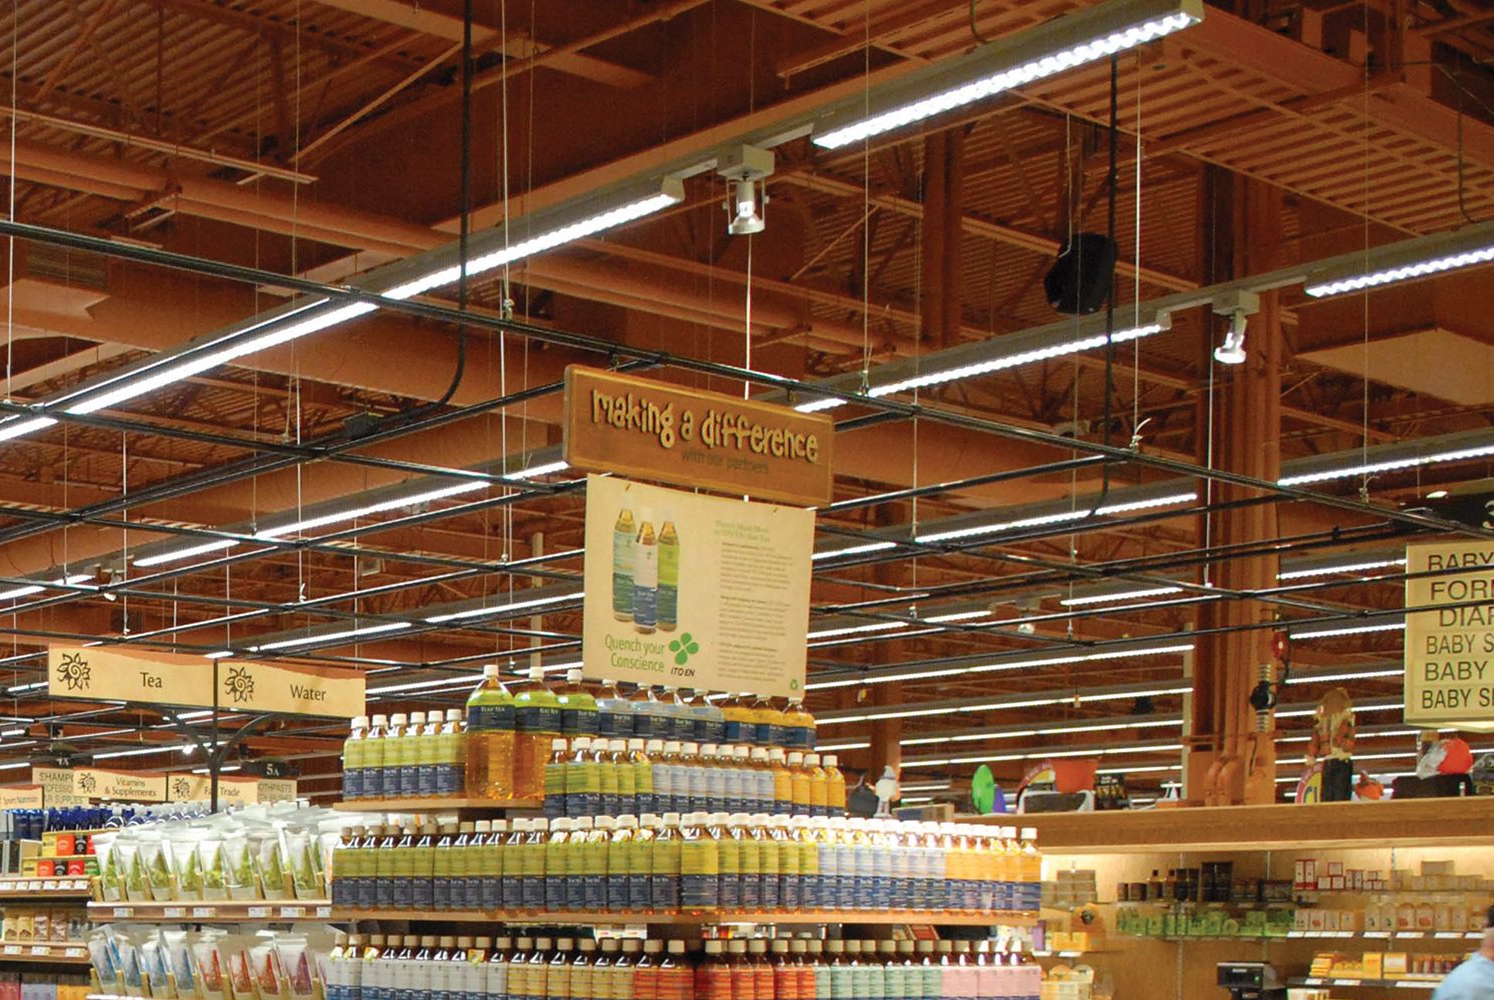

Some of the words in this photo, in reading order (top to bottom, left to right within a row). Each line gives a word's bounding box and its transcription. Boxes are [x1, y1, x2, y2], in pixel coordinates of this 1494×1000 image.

[592, 389, 675, 448] making
[681, 410, 693, 441] a
[701, 410, 819, 463] difference
[1431, 580, 1494, 601] FOR
[605, 634, 641, 651] Quench
[644, 643, 664, 655] your
[1427, 634, 1476, 655] BABY
[611, 652, 664, 672] Conscience
[671, 668, 683, 676] ITO
[1425, 660, 1487, 681] BABY
[140, 672, 161, 689] Tea
[290, 684, 326, 702] Water
[1422, 689, 1471, 709] BABY
[113, 787, 156, 796] Supplements
[116, 777, 146, 787] Vitamins
[220, 787, 239, 796] Trade
